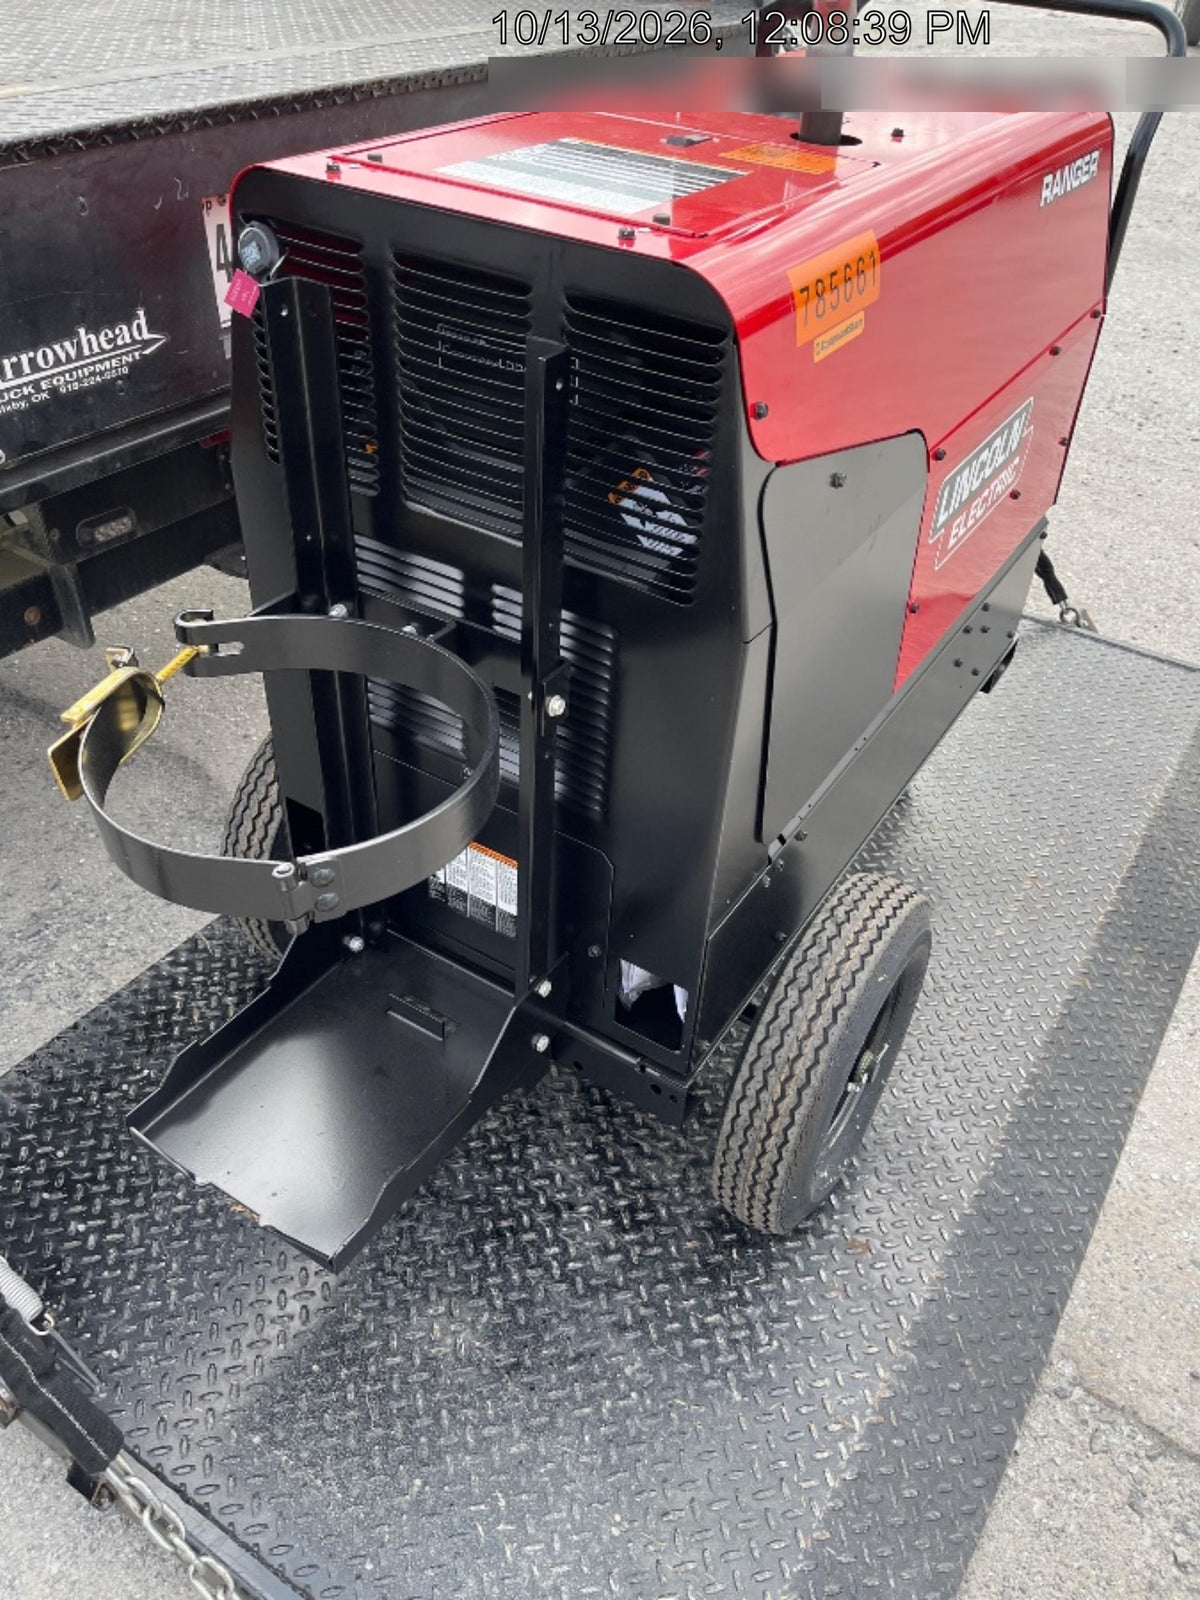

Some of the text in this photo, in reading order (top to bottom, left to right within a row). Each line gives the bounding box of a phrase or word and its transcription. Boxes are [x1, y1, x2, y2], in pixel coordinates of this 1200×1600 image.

[1040, 150, 1100, 207] RANGER
[799, 251, 875, 327] 785661
[31, 391, 50, 402] OK
[40, 350, 142, 391] EQUIPMENT
[937, 411, 1027, 528] LINCOLN
[948, 462, 1017, 550] ELECTRIC
